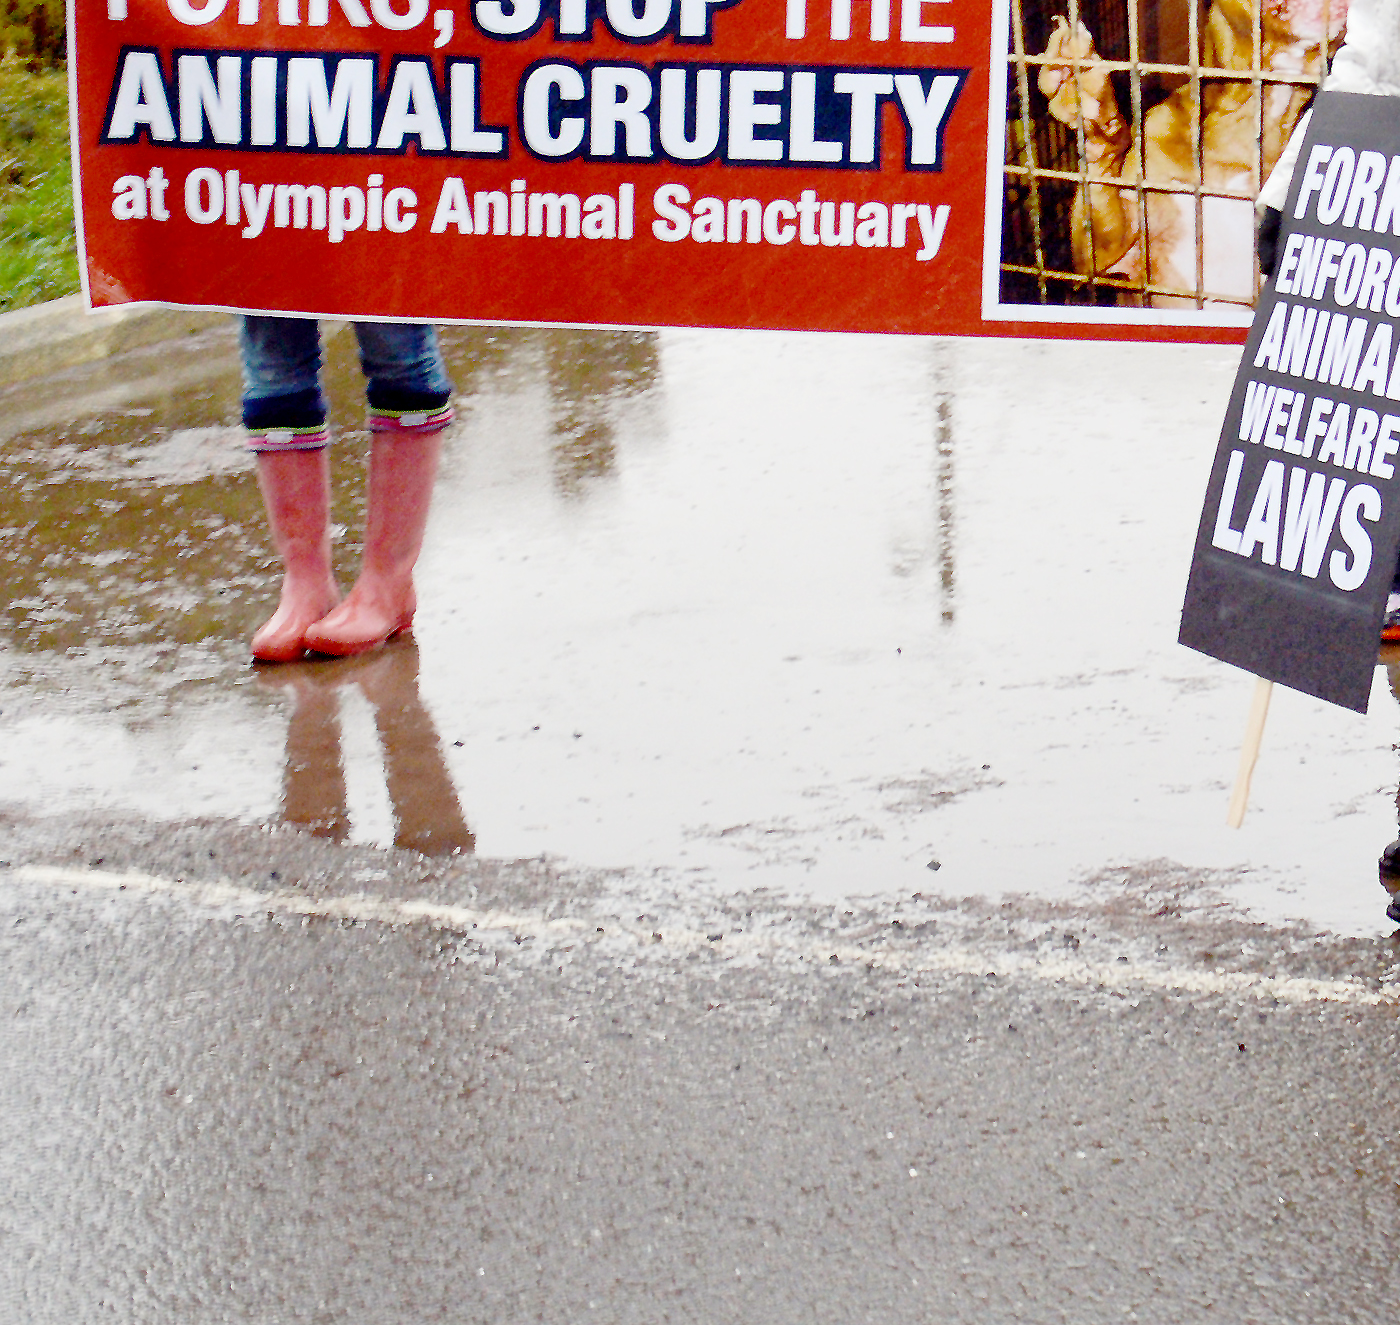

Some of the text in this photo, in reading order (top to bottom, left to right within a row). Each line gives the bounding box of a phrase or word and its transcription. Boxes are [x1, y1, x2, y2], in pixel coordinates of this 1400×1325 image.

[106, 50, 961, 166] ANIMAL CRUELTY
[110, 166, 952, 262] at Olympic Animal Sanctuary
[1210, 448, 1383, 593] LAWS
